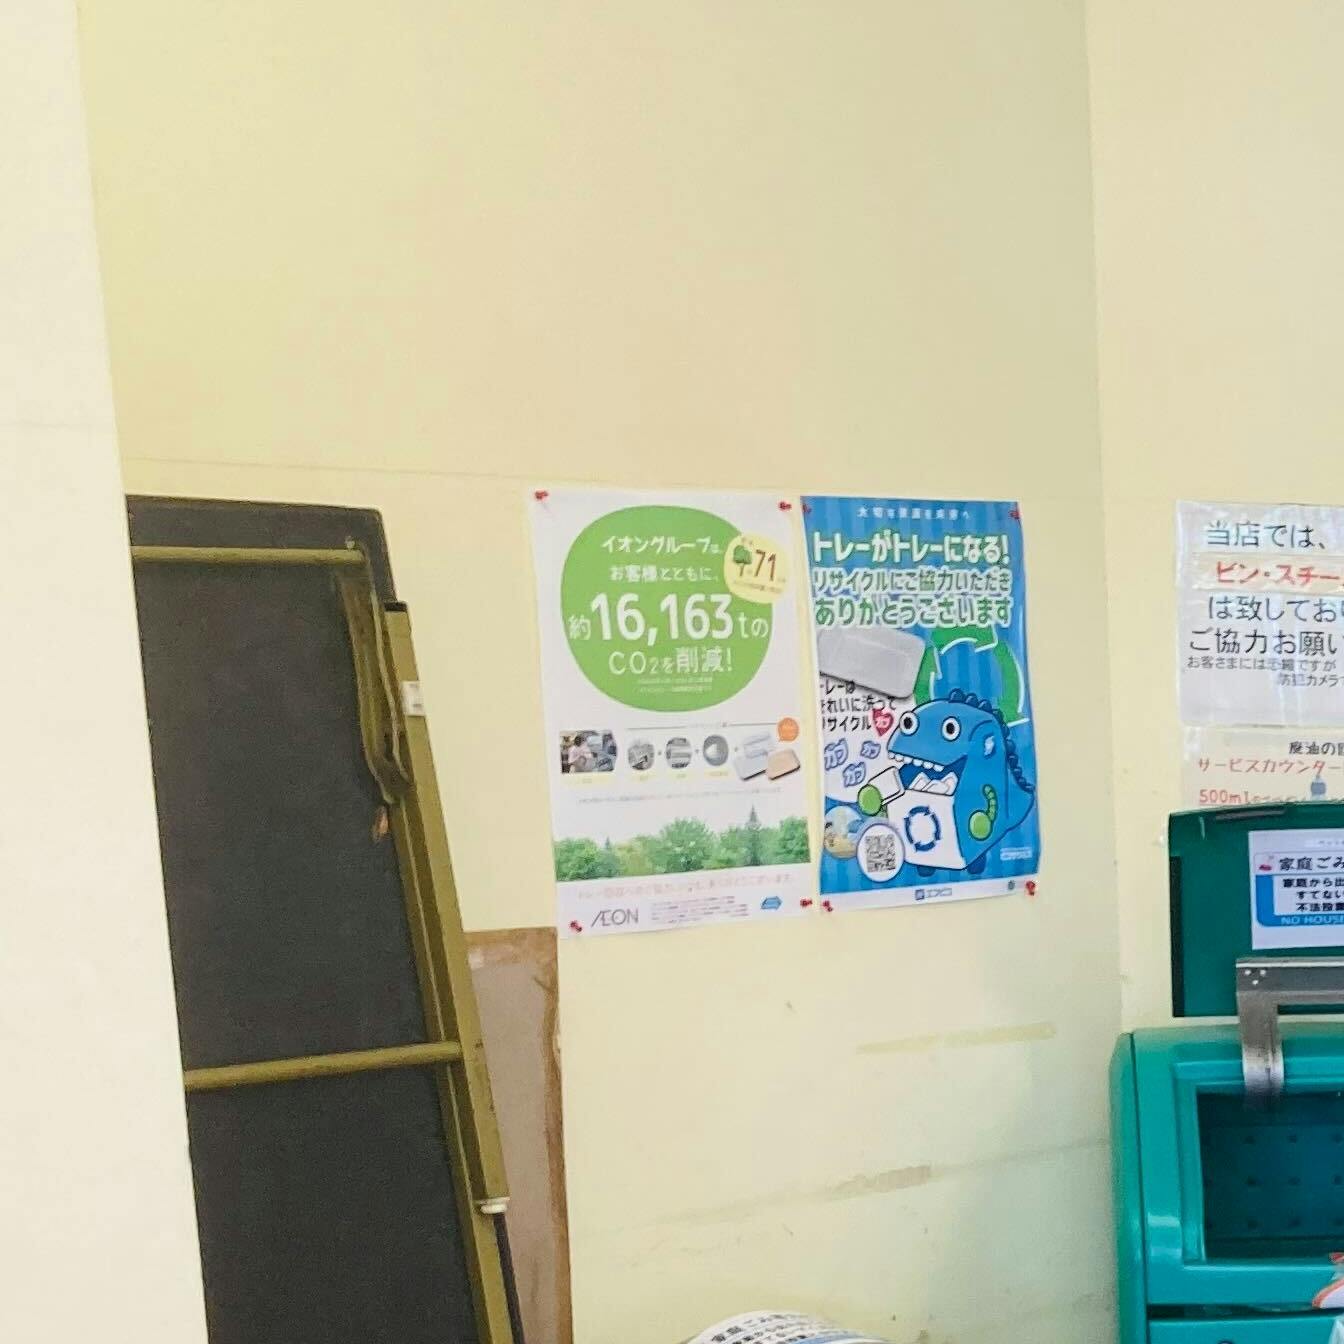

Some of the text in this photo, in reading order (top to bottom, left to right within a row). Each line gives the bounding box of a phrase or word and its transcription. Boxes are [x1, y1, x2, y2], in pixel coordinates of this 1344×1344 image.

[1206, 522, 1327, 549] 当店では、
[755, 549, 777, 582] 71
[814, 569, 1012, 593] リサイクルにご協力いただき
[815, 598, 1012, 626] ありがとうございます
[1281, 915, 1300, 925] NO
